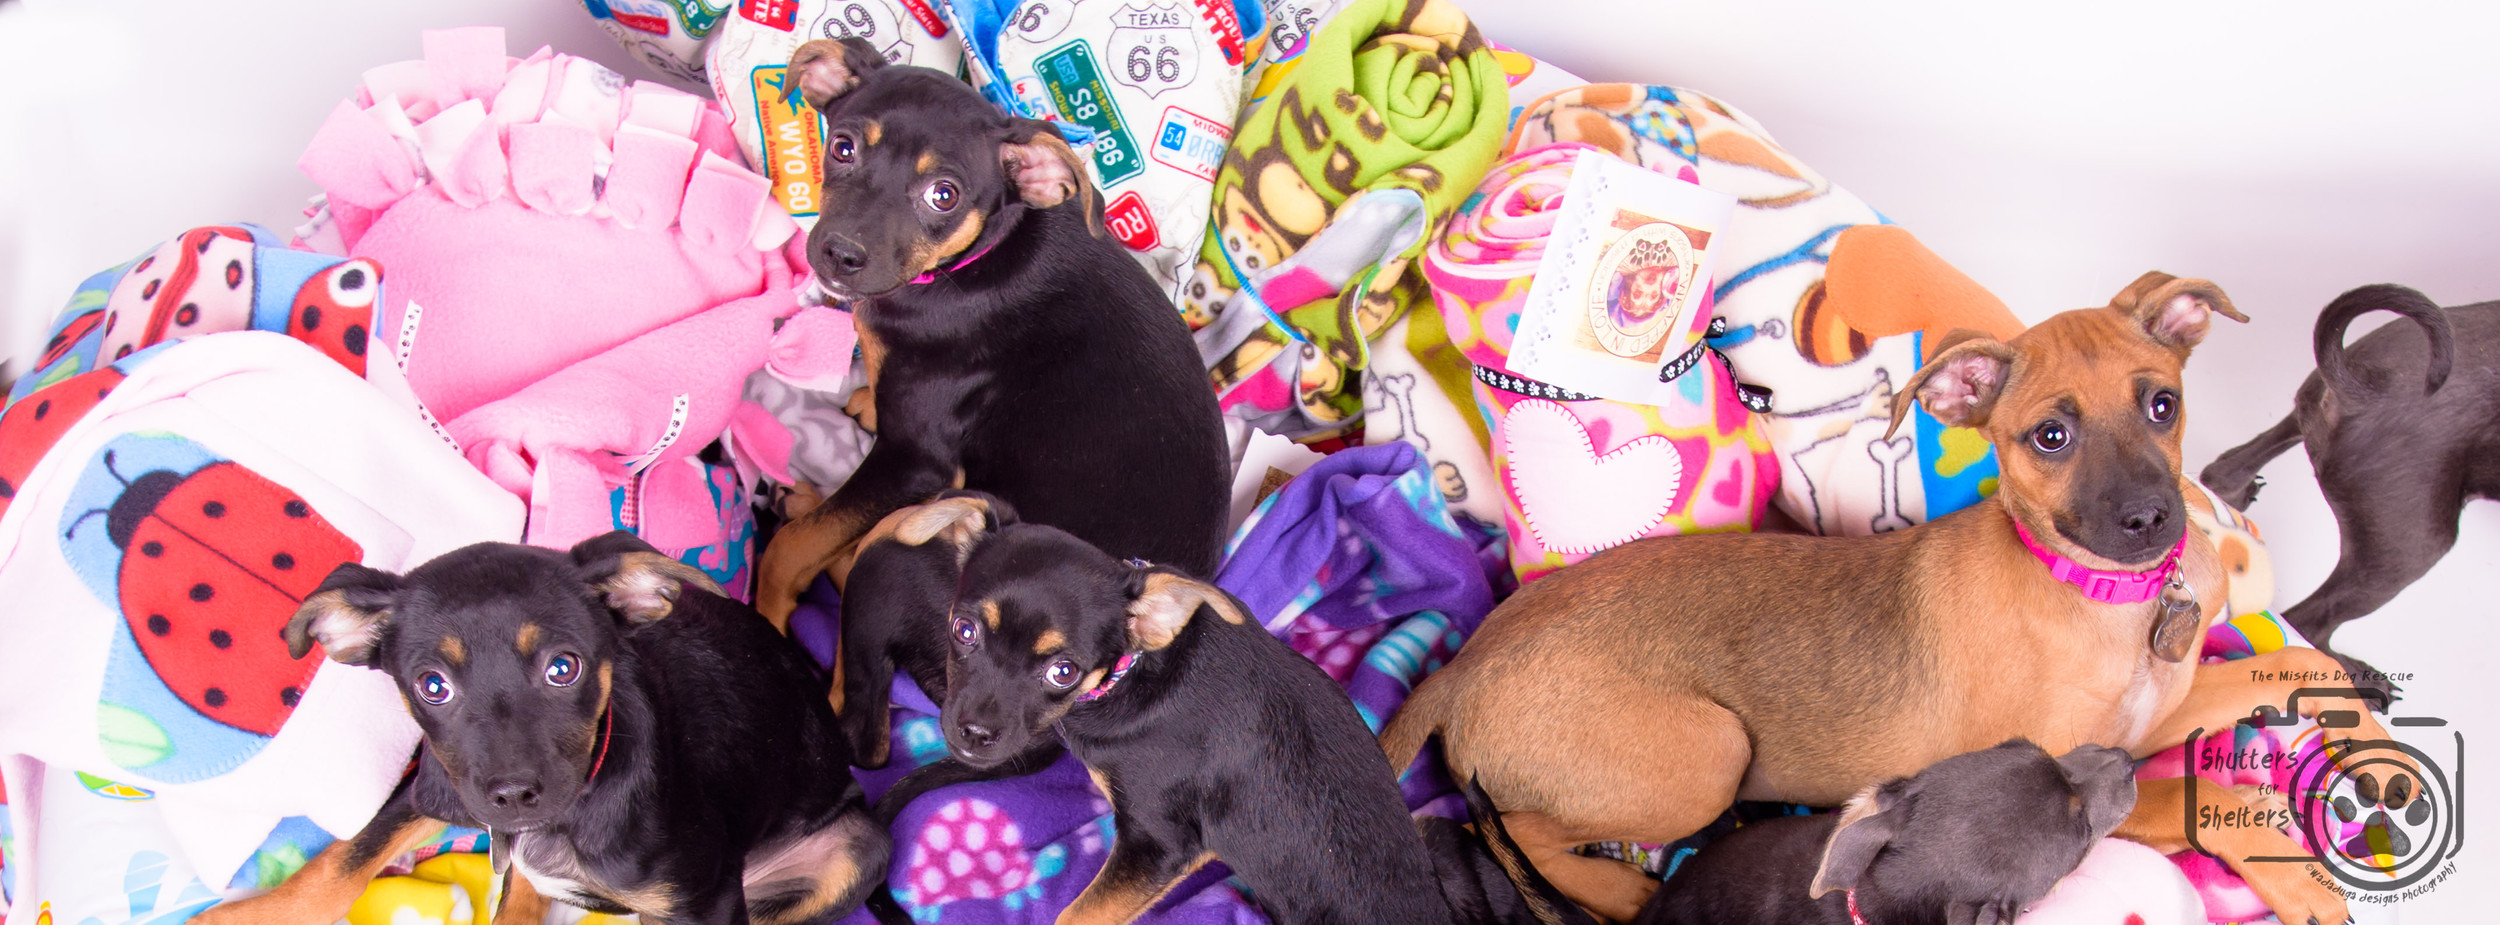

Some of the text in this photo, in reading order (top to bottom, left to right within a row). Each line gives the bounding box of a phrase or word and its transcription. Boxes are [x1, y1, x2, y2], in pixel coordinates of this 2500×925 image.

[1129, 13, 1180, 26] TEXAS
[1054, 55, 1080, 84] USA
[1127, 45, 1180, 82] 66
[1089, 79, 1121, 132] MISSOURI
[760, 100, 780, 187] Native America
[804, 112, 823, 185] OKLAHOMA
[1164, 126, 1184, 147] 54
[779, 120, 812, 211] WYO 60
[1115, 209, 1147, 239] RO
[1592, 295, 1613, 341] LOVE
